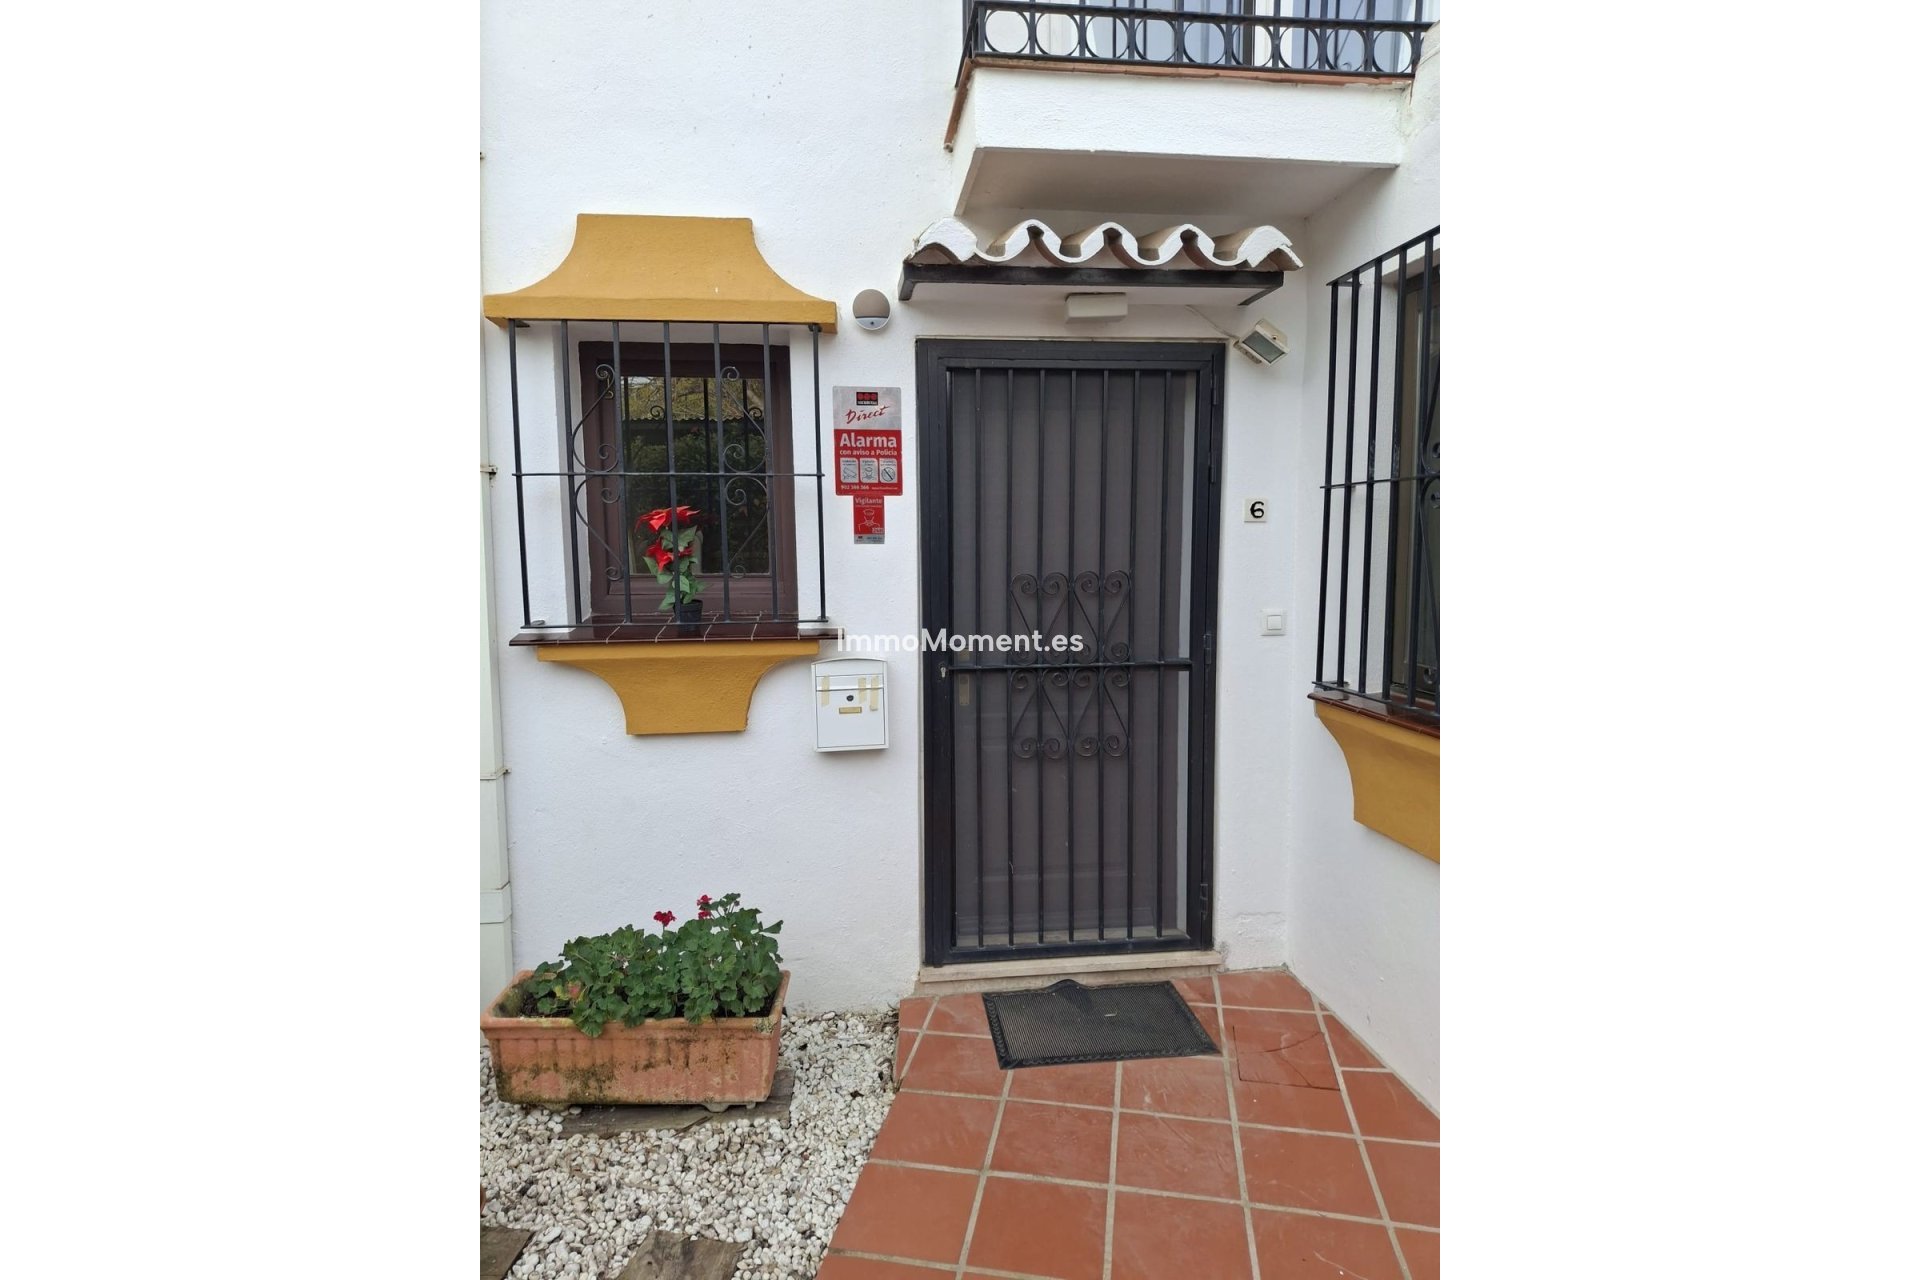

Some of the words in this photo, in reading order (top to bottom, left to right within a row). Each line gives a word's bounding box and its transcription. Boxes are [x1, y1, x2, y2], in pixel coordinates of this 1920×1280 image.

[845, 406, 890, 424] Direct
[840, 432, 897, 448] Alarma
[855, 497, 883, 505] Vigilante
[1250, 501, 1264, 518] 6
